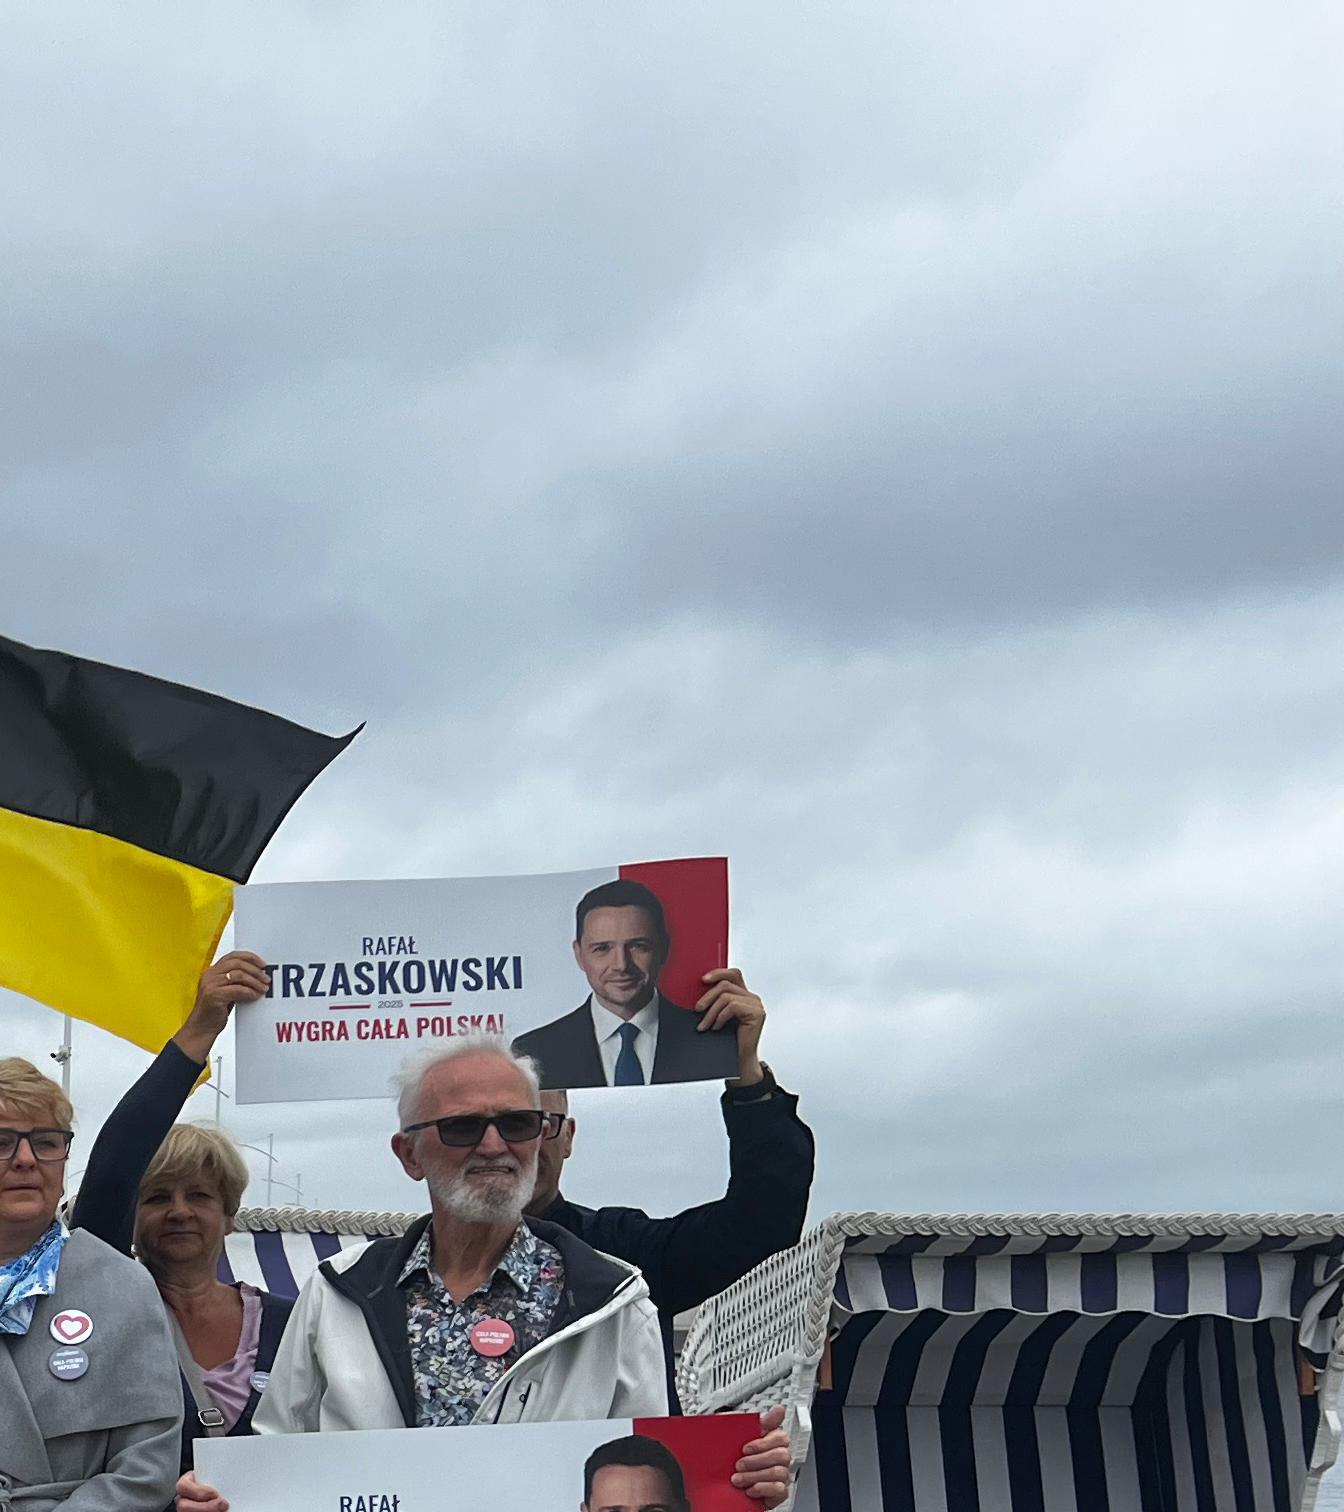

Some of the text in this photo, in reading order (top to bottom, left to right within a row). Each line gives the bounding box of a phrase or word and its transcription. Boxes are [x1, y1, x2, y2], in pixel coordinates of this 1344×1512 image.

[362, 936, 418, 956] RAFAŁ
[264, 956, 523, 999] TRZASKOWSKI
[377, 1000, 404, 1009] 2025
[276, 1014, 504, 1043] WYGRA CAŁA POLSKA!
